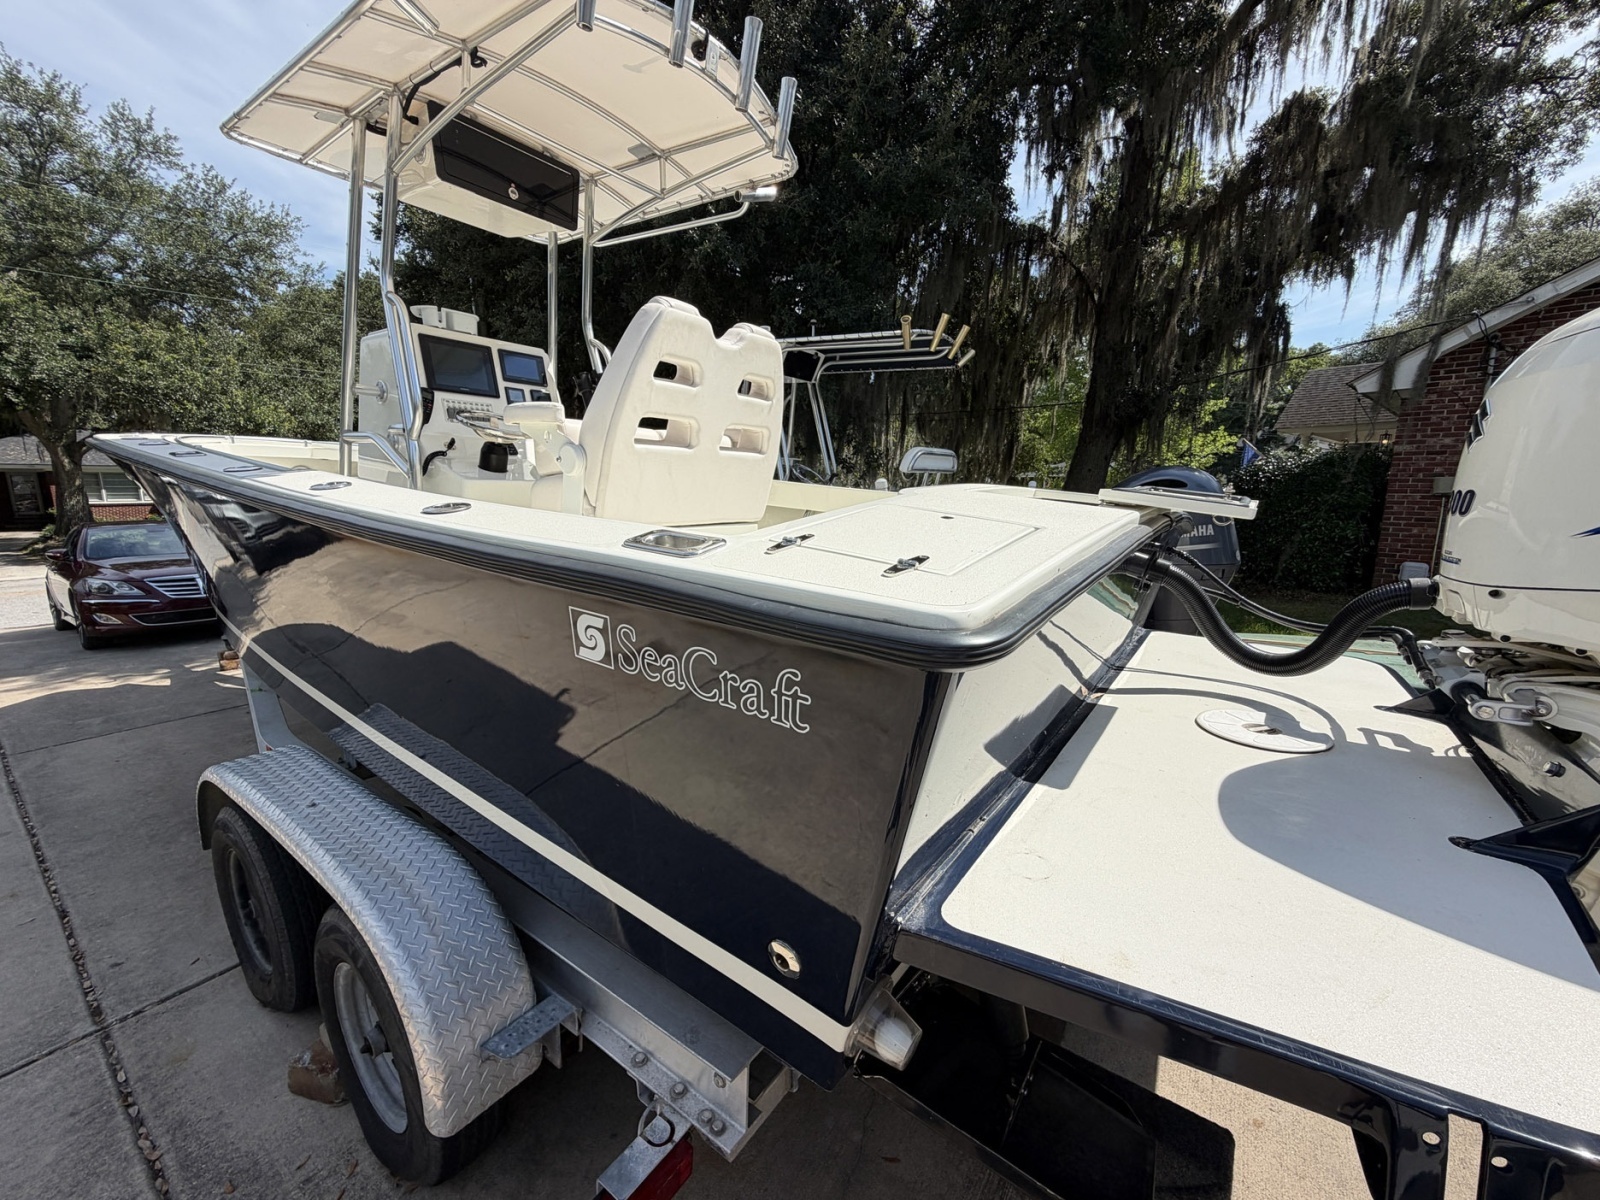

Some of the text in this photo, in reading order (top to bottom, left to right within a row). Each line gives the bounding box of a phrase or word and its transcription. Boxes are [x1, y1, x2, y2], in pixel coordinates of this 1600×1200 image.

[1450, 489, 1476, 516] 00
[1181, 524, 1215, 537] AHA
[616, 623, 812, 733] SeaCraft
